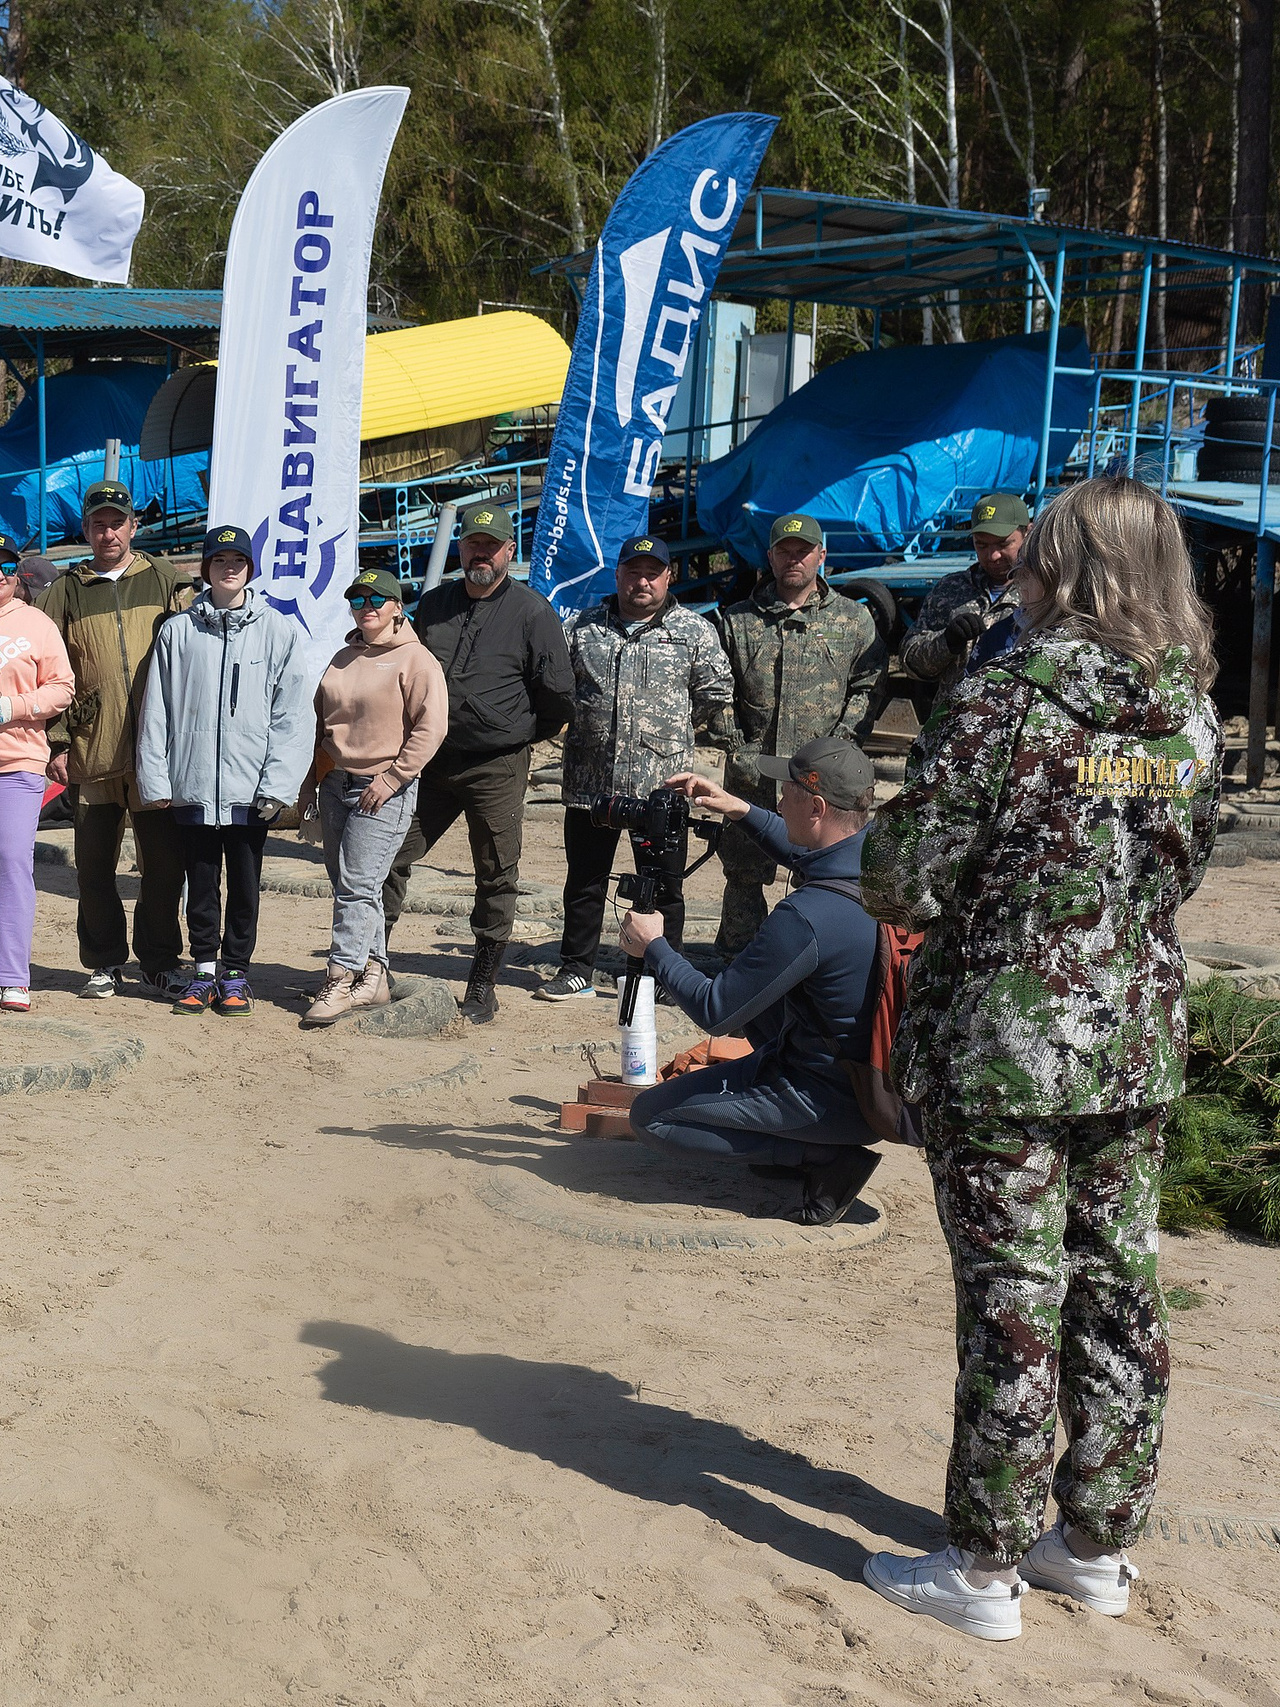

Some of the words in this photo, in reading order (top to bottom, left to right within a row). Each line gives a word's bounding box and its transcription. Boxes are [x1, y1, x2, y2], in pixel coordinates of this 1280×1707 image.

[272, 189, 334, 580] НАВИГАТОР
[623, 167, 738, 498] БАДИС
[545, 458, 577, 580] ooo-badis.ru
